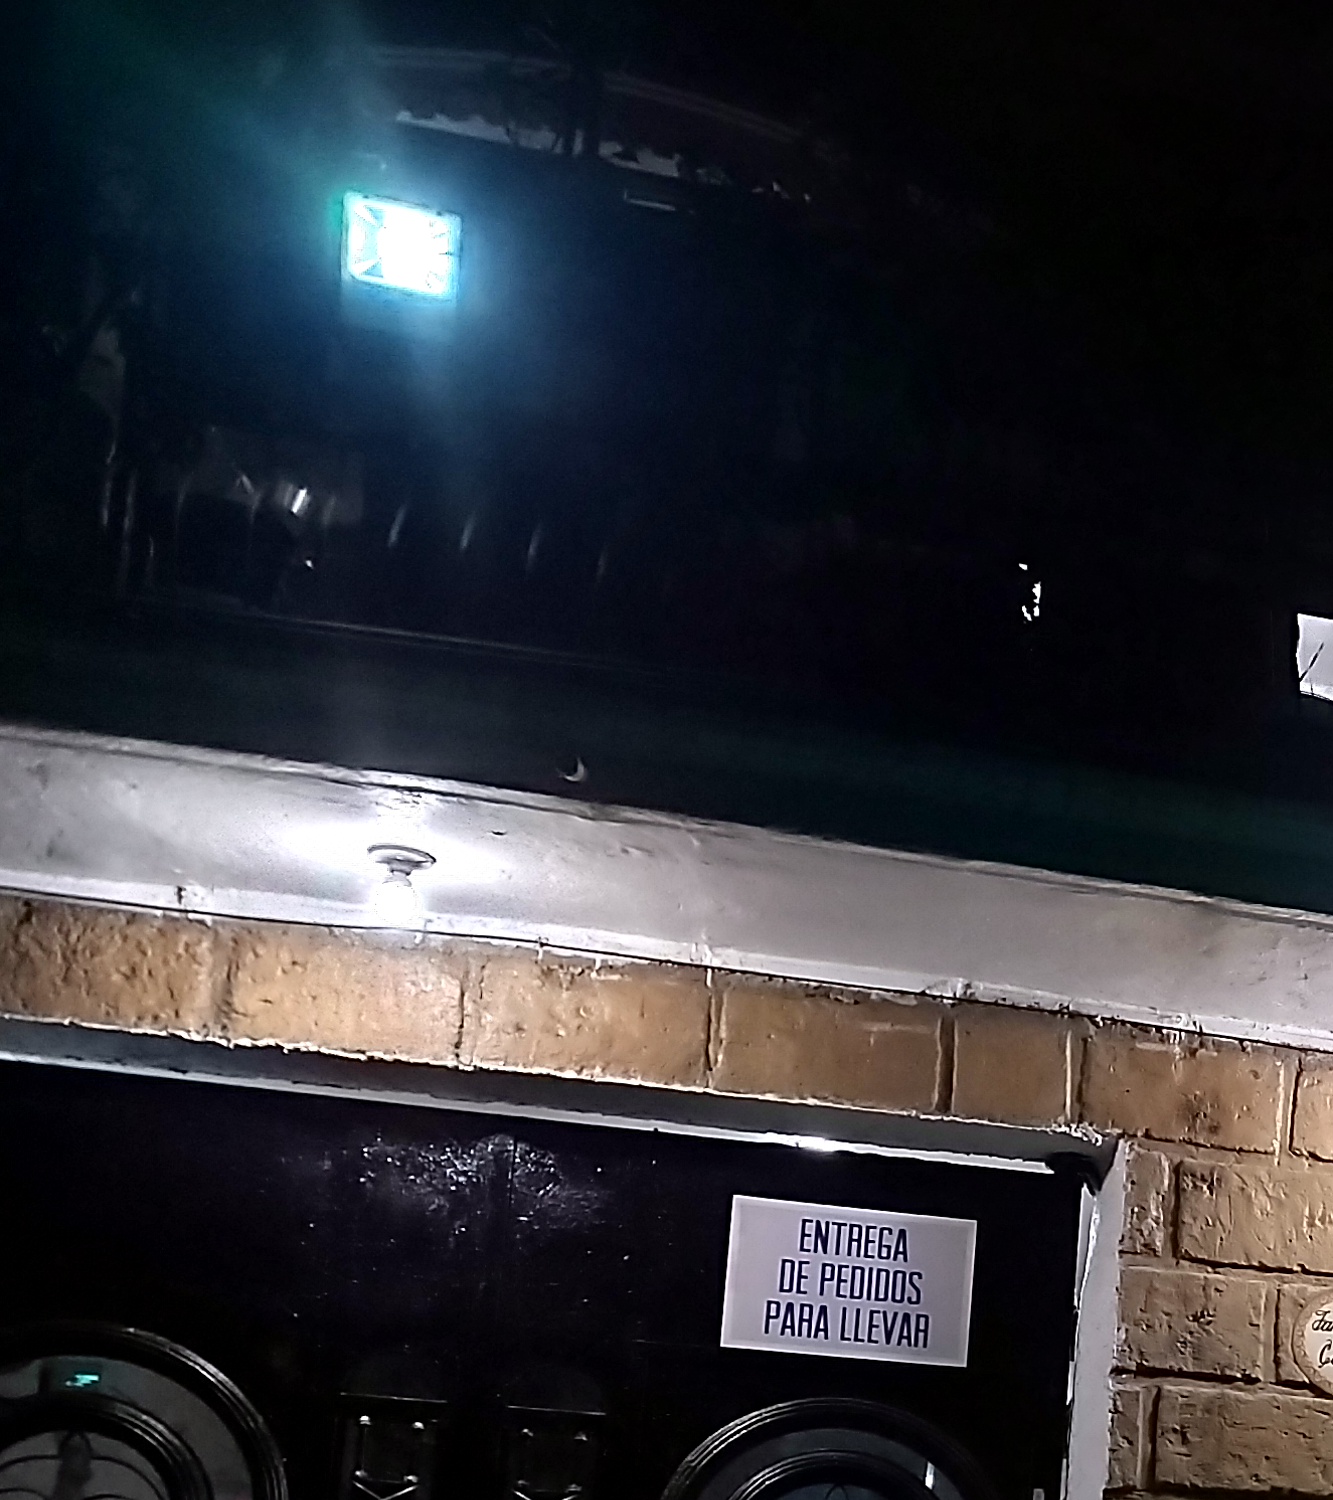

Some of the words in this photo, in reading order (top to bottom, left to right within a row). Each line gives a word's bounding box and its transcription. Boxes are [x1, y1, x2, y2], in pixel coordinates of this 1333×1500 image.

[799, 1218, 908, 1263] ENTREGA
[778, 1258, 811, 1295] DE
[819, 1262, 924, 1305] PEDIDOS
[764, 1300, 829, 1340] PARA
[840, 1307, 930, 1348] LLEVAR
